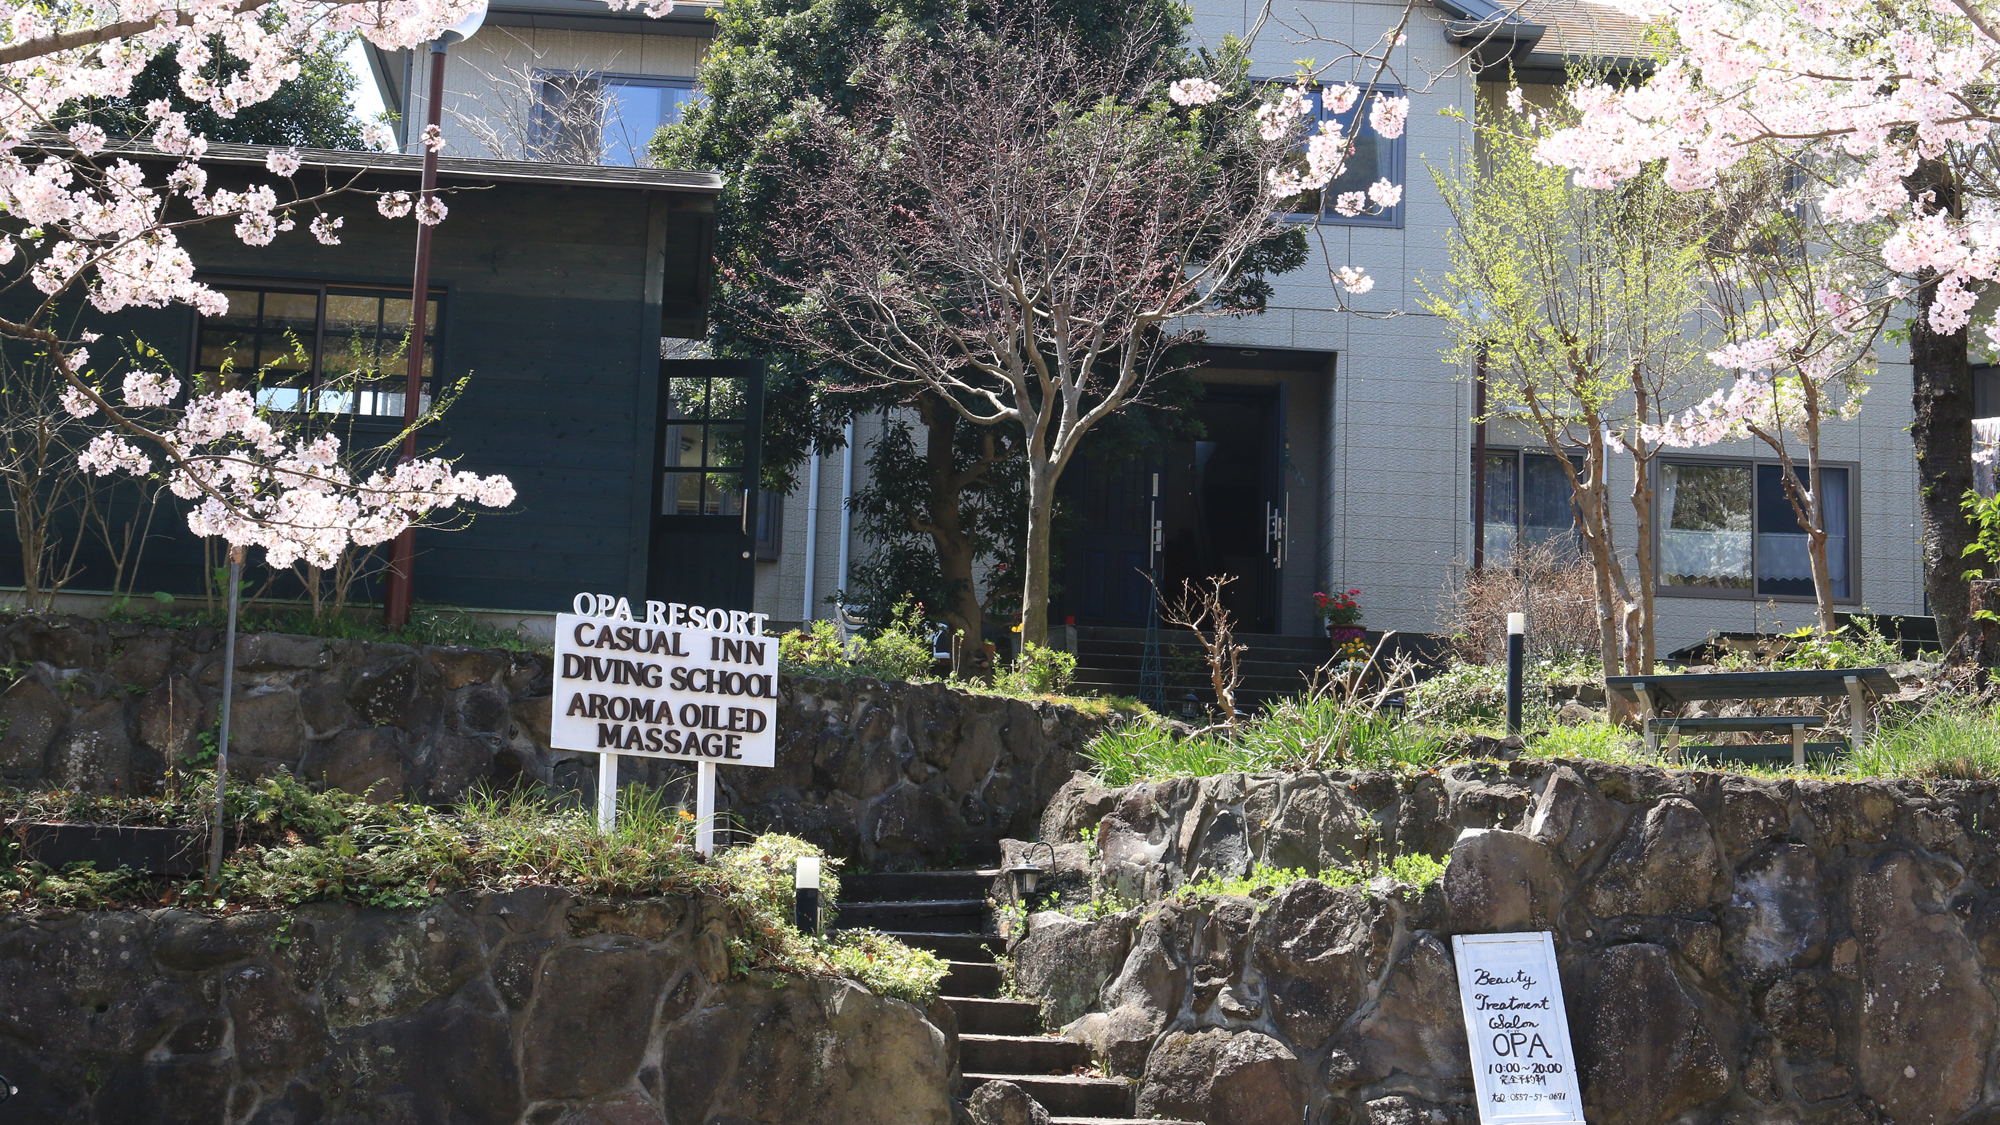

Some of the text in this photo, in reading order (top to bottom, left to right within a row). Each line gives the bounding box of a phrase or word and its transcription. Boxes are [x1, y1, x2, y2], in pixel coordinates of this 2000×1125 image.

[572, 592, 769, 635] OPA RESORT
[574, 623, 766, 666] CASUAL INN
[562, 653, 779, 699] DIVING SCHOOL
[566, 692, 767, 733] AROMA OILED
[597, 723, 743, 759] MASSAGE
[1474, 968, 1537, 990] Beauty
[1474, 993, 1550, 1011] Treatment
[1488, 1014, 1540, 1029] Salon
[1493, 1033, 1553, 1058] OPA
